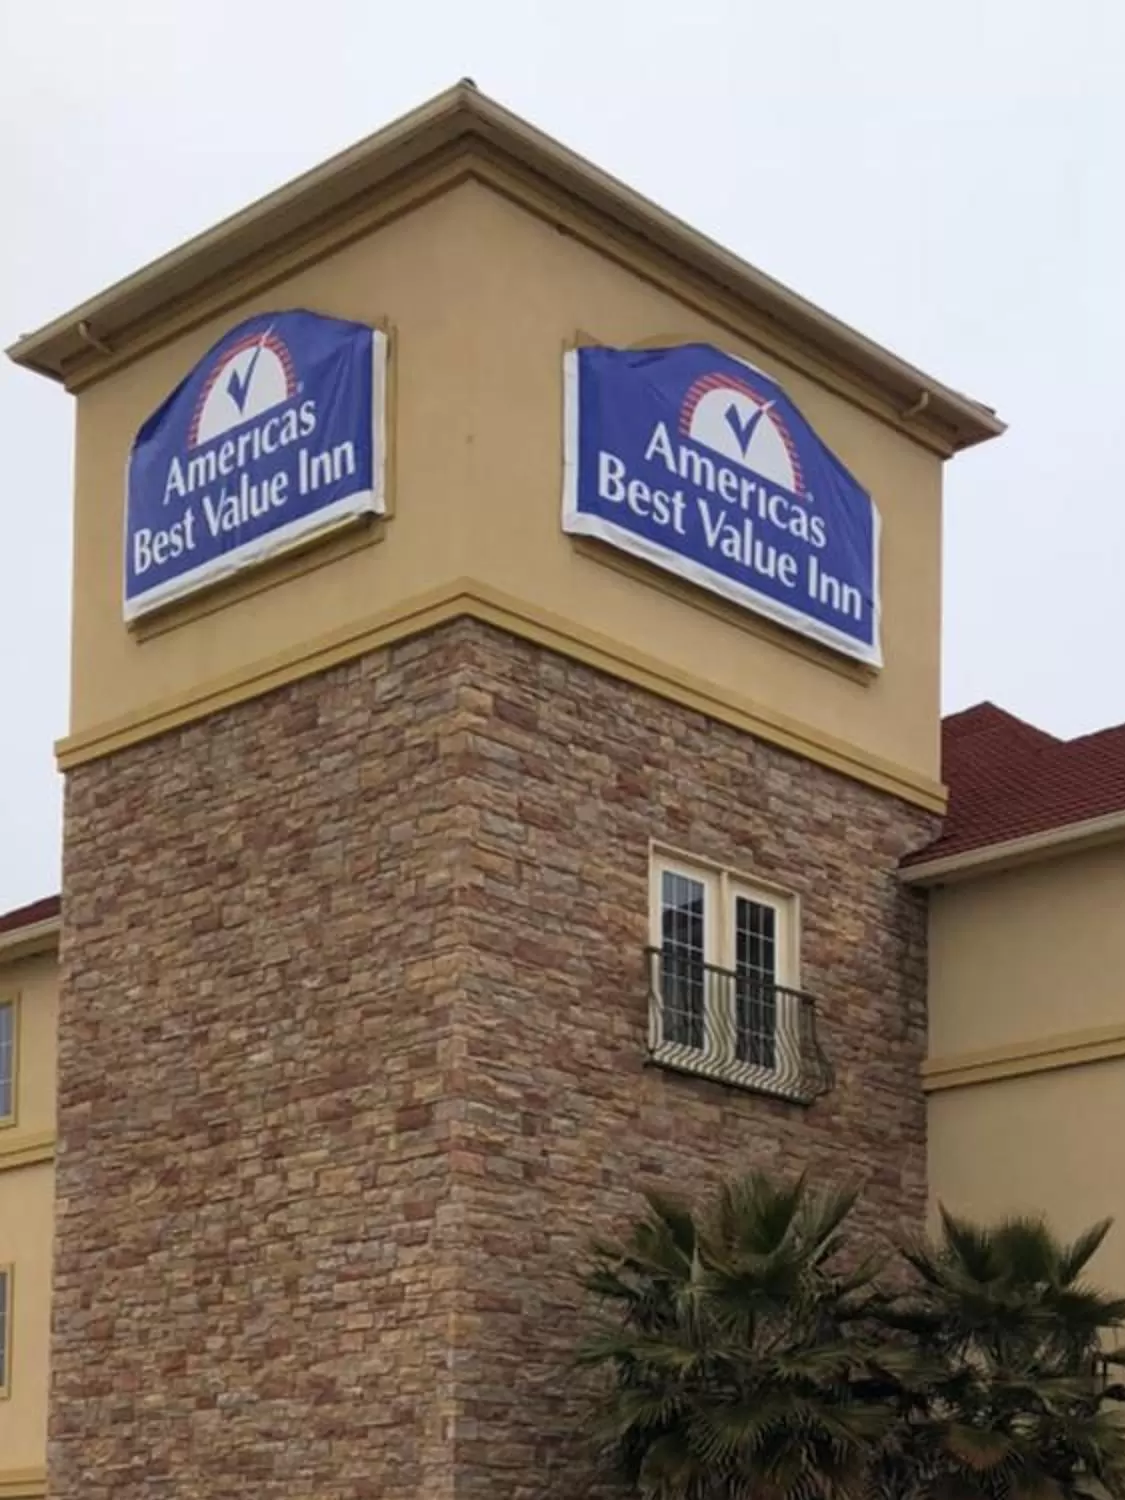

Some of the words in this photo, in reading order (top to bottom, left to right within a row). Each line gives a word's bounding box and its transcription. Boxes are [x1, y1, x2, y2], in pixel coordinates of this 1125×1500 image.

[133, 508, 196, 575] Best
[202, 472, 288, 537] Value
[299, 440, 355, 495] Inn
[163, 400, 317, 506] Americas
[645, 421, 826, 548] Americas
[598, 451, 686, 534] Best
[697, 497, 798, 588] Value
[808, 556, 861, 620] Inn
